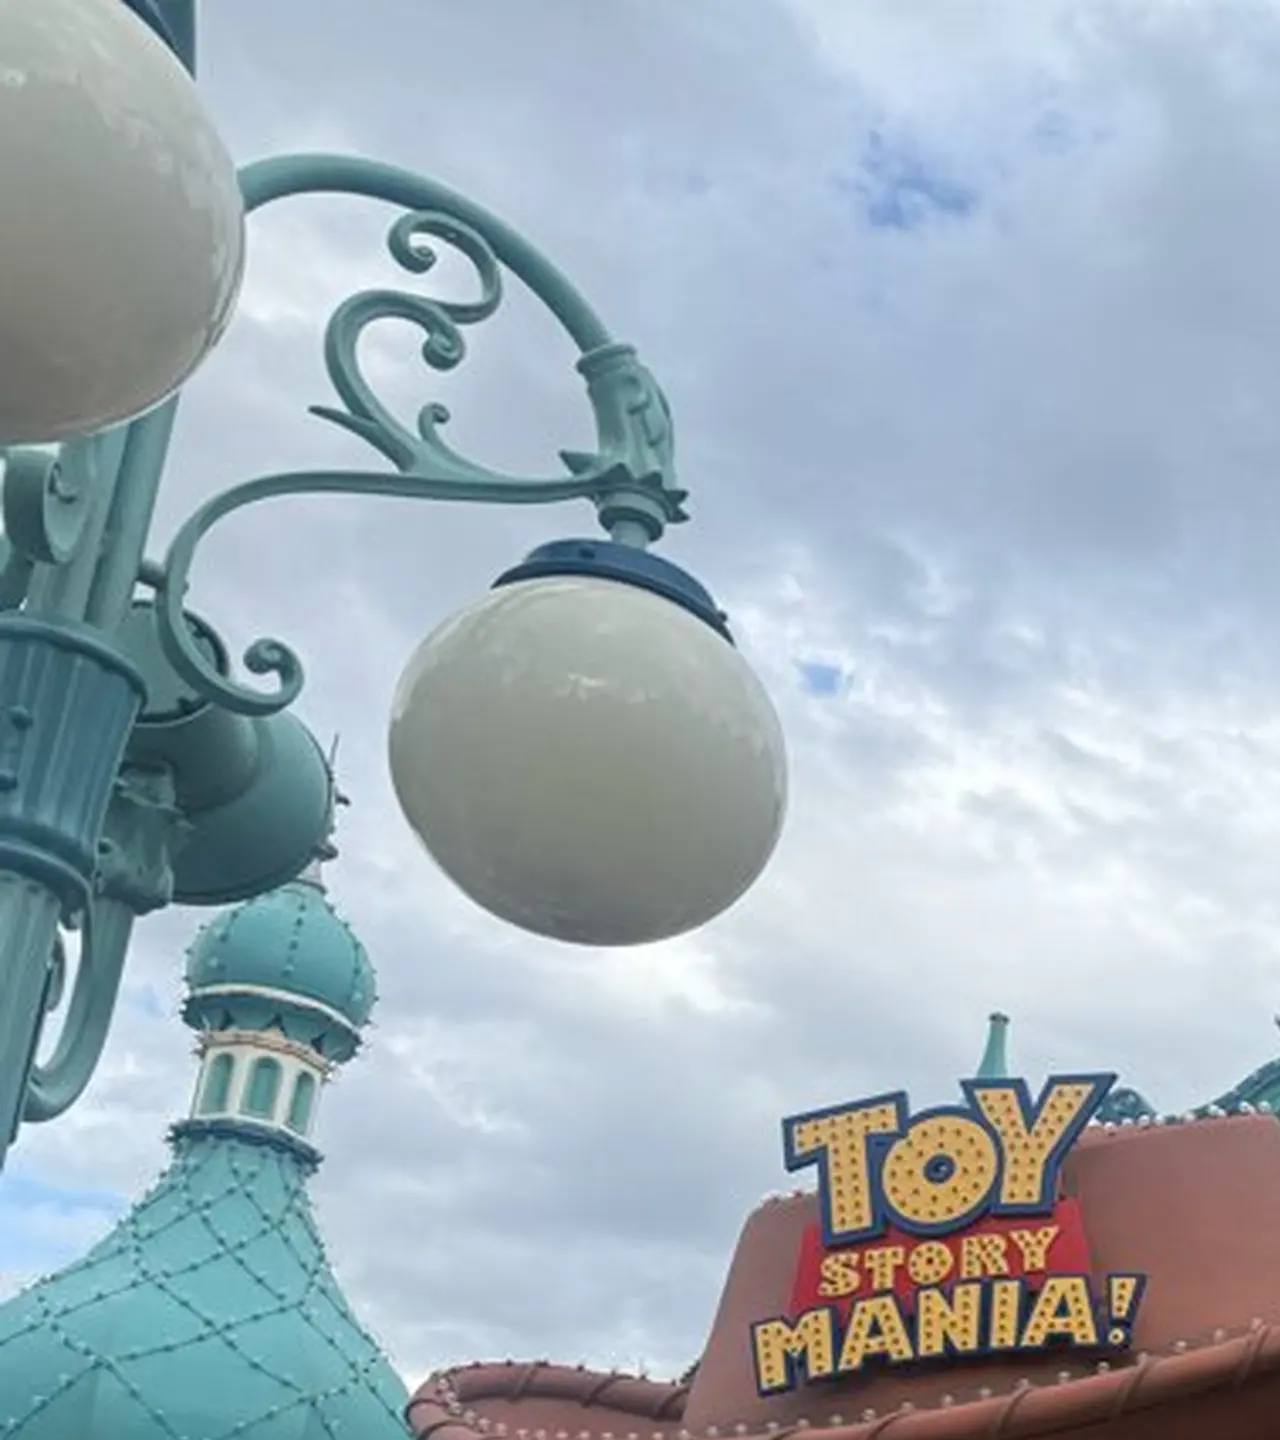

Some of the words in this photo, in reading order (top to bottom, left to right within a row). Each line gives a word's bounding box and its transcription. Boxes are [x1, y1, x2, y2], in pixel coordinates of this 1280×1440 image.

[783, 1072, 1117, 1245] TOY
[818, 1226, 1060, 1297] STORY
[750, 1273, 1147, 1397] MANIA!
